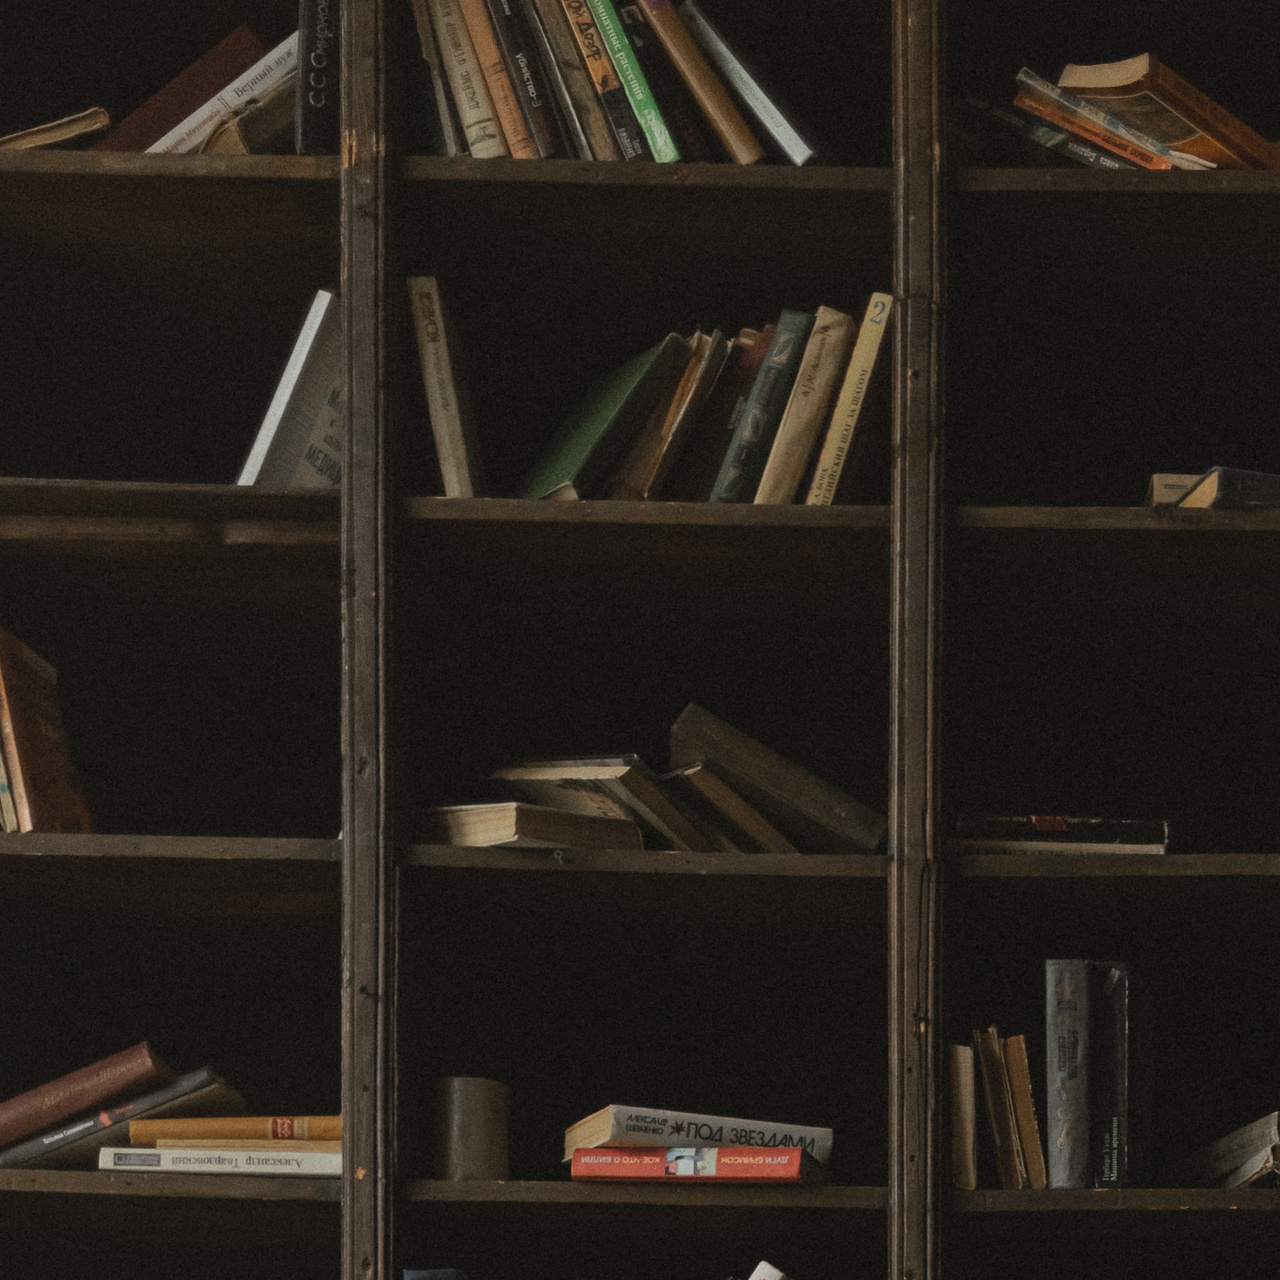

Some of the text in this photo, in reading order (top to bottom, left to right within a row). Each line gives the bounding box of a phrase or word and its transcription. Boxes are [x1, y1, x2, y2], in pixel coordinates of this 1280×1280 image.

[231, 62, 276, 100] Верный
[612, 49, 647, 103] растения
[685, 1122, 724, 1142] ПОД
[170, 1154, 303, 1168] Александр Твардовский
[1107, 1148, 1122, 1181] Машина
